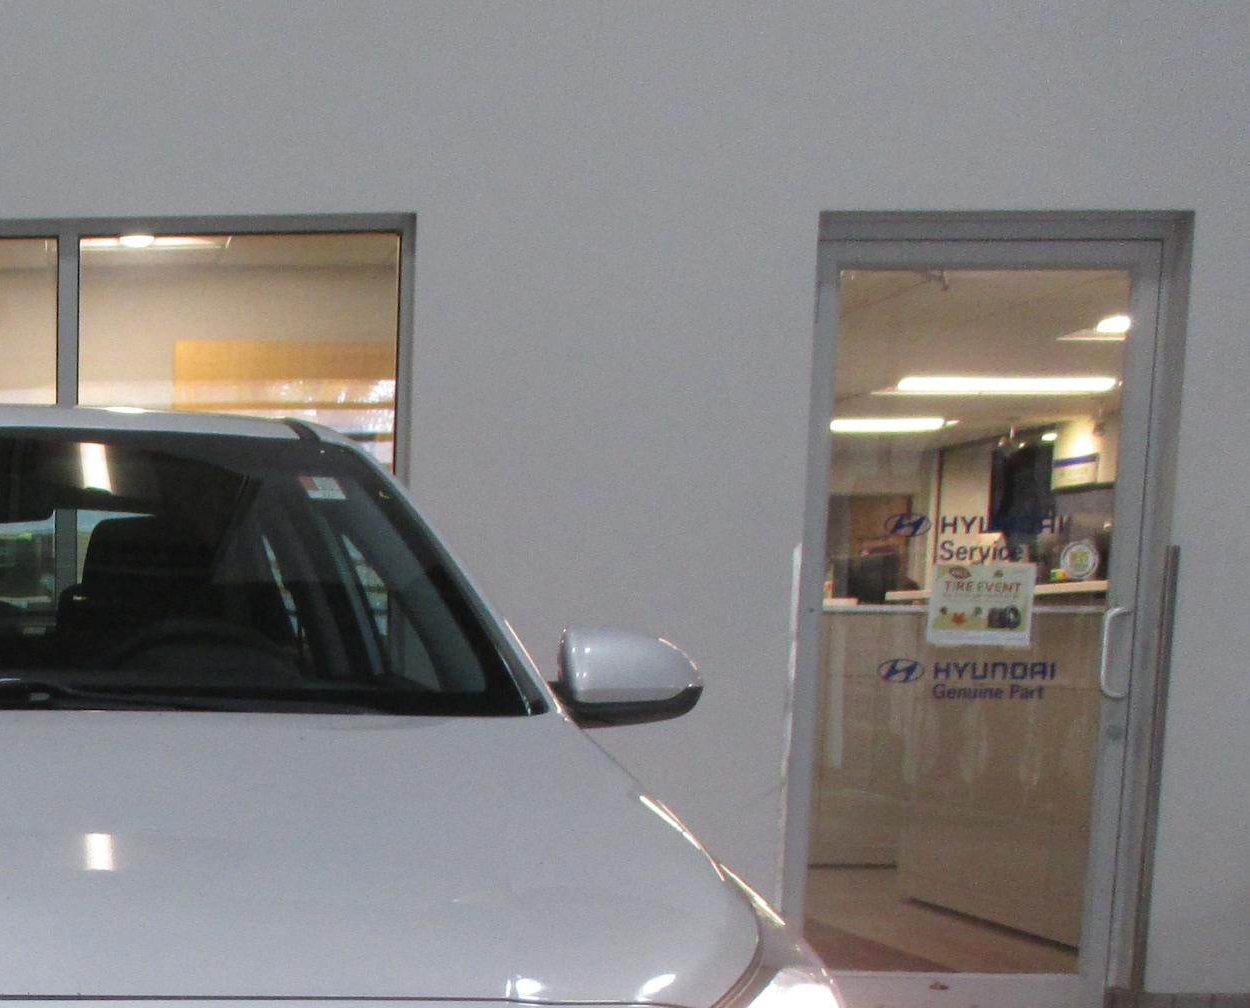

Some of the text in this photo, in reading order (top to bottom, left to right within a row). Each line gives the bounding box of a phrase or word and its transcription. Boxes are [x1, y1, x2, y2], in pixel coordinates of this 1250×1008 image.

[940, 514, 1064, 534] HYUAI
[939, 540, 1024, 565] Service
[944, 581, 1022, 593] TIRE EVENT
[933, 661, 1057, 680] HYUNDAI
[932, 683, 1045, 700] Genuine Part
